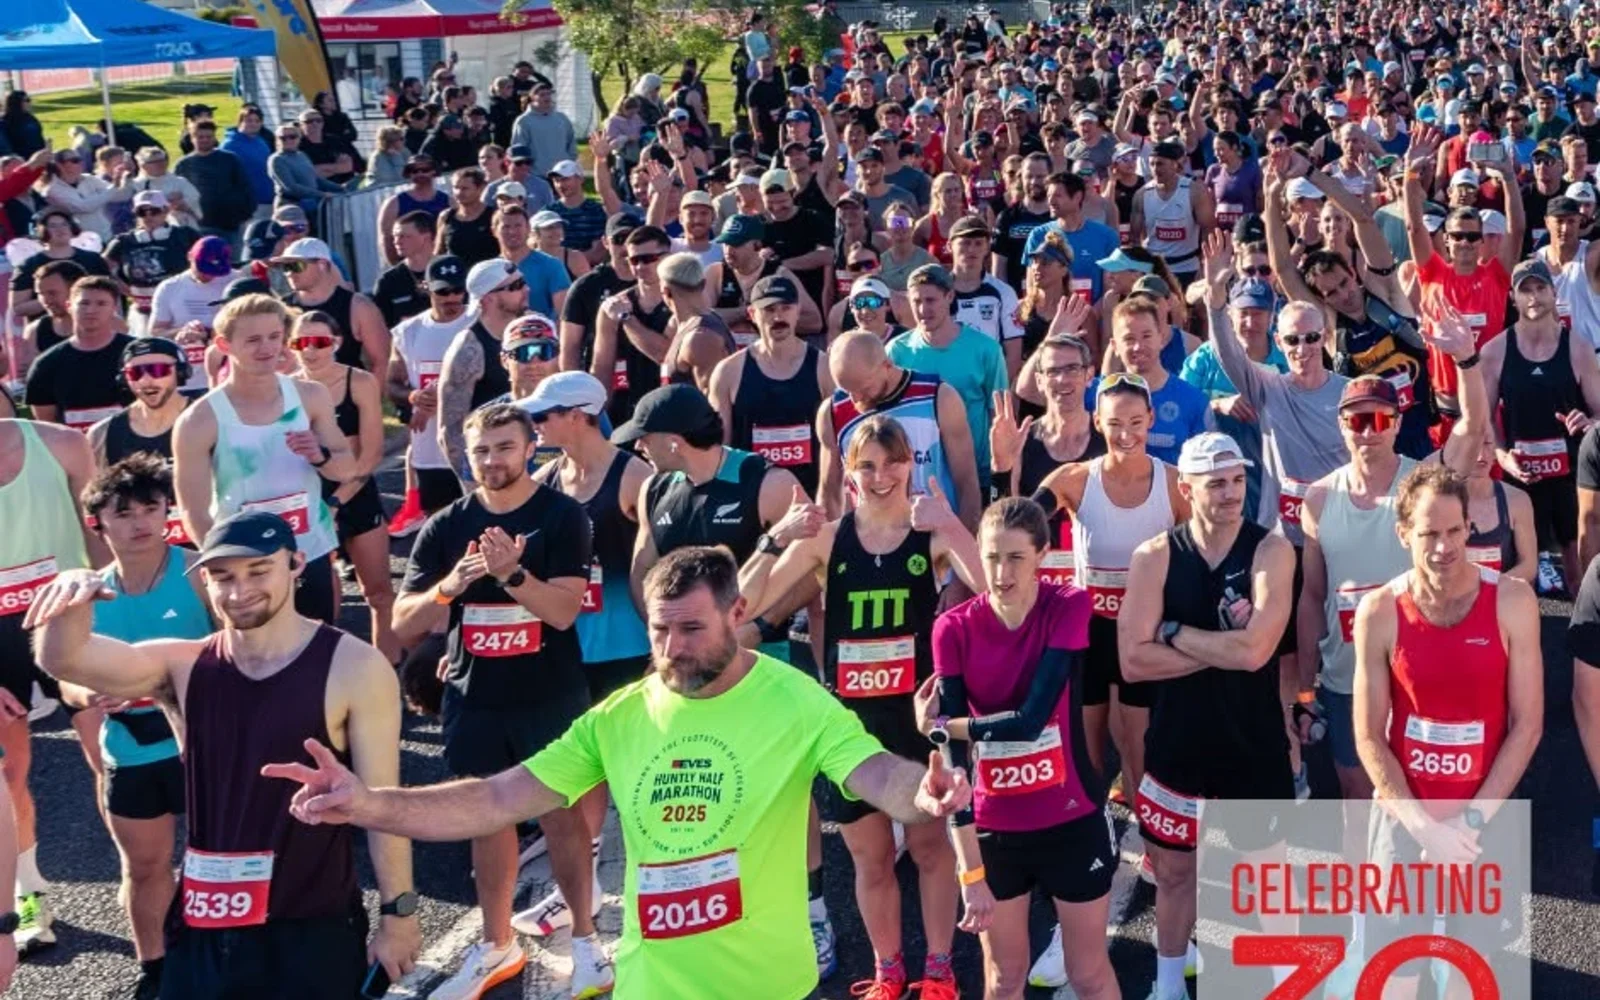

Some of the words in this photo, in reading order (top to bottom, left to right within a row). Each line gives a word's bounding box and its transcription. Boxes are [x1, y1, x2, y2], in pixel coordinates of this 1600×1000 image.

[760, 445, 804, 462] 2653
[0, 583, 46, 609] 69
[848, 588, 910, 630] TTT
[472, 630, 530, 651] 2474
[845, 667, 904, 690] 2607
[990, 759, 1054, 788] 2203
[1409, 748, 1472, 775] 2650
[653, 773, 696, 787] HUNTLY
[699, 772, 724, 786] HALF
[650, 785, 722, 805] MARATHON
[662, 804, 707, 822] 2025
[1140, 804, 1189, 840] 2454
[184, 889, 252, 918] 2539
[647, 894, 728, 931] 2016
